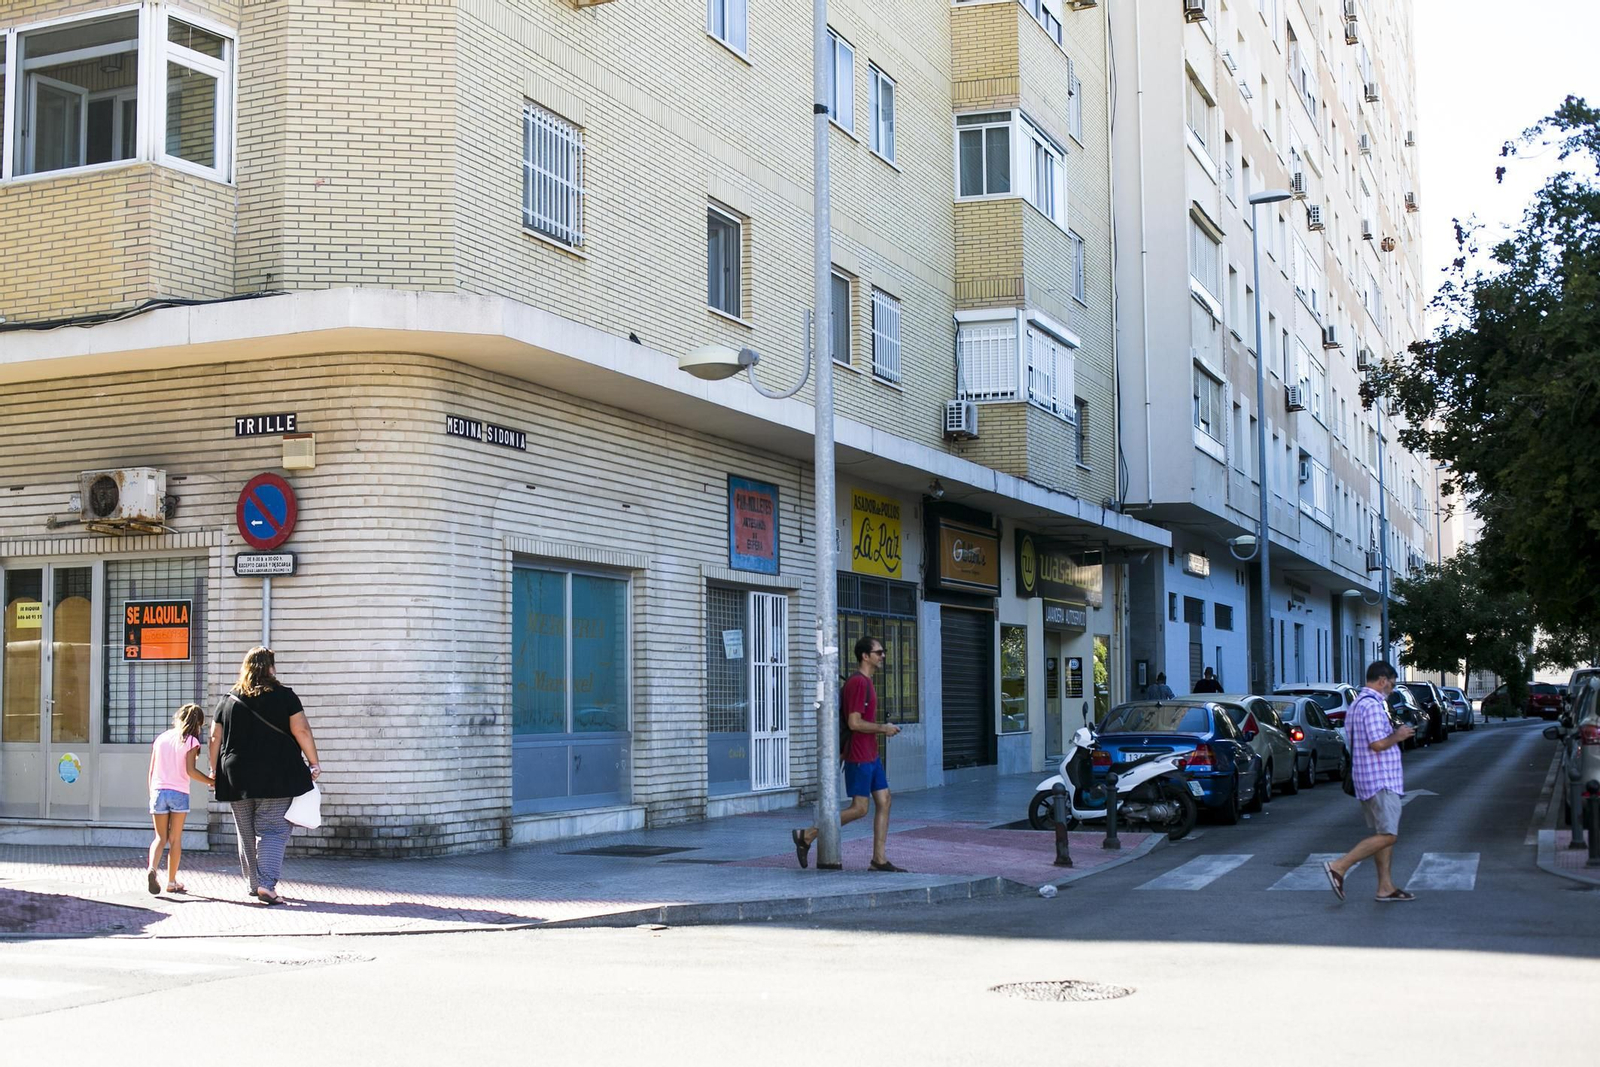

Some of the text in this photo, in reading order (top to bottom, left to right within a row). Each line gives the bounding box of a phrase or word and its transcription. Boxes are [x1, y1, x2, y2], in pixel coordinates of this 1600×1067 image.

[236, 415, 295, 435] TRILLE
[447, 417, 526, 449] MEDINA SIDONIA
[853, 494, 876, 514] ASADOR
[881, 501, 900, 520] POLLOS
[853, 517, 874, 561] La
[873, 523, 901, 573] Paz
[127, 605, 188, 625] SE ALQUILA
